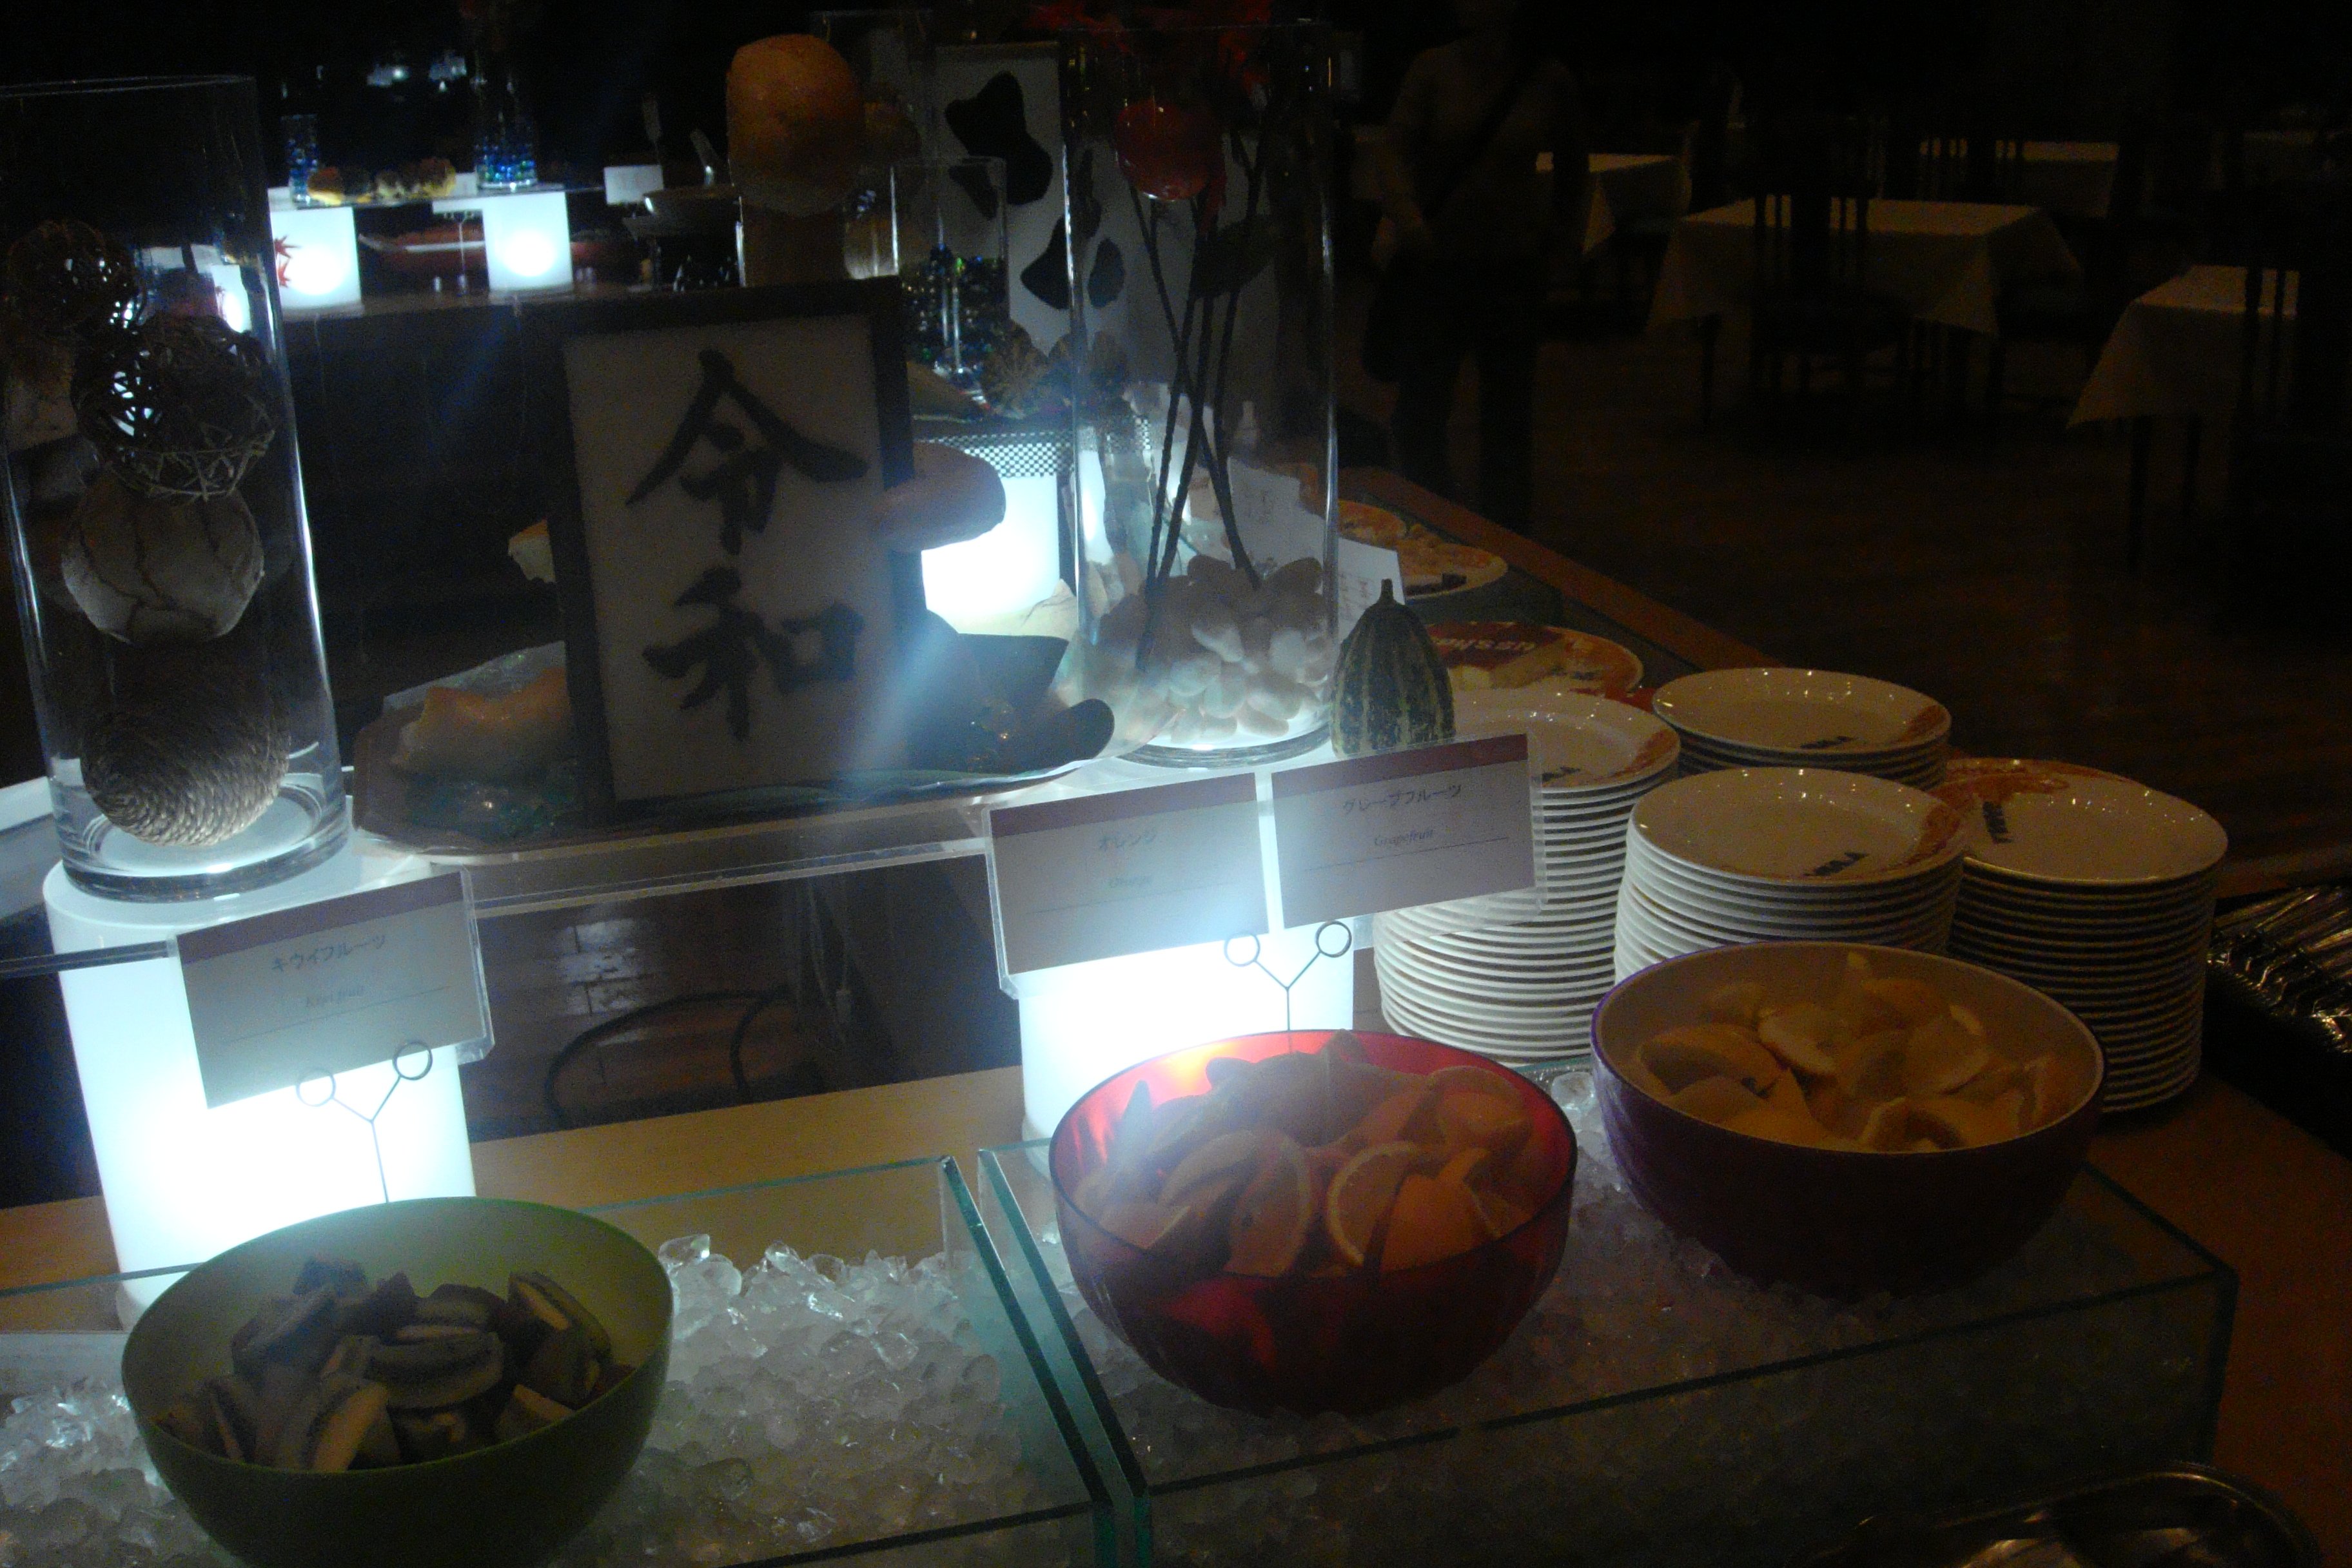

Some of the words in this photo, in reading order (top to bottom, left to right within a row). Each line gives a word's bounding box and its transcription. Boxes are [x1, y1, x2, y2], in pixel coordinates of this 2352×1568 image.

[624, 348, 870, 743] 令和
[1343, 784, 1461, 816] グレープフルーツ
[1098, 826, 1158, 852] オレンジ
[1373, 828, 1434, 847] Grapefruit
[271, 934, 386, 972] キウイフルーツ
